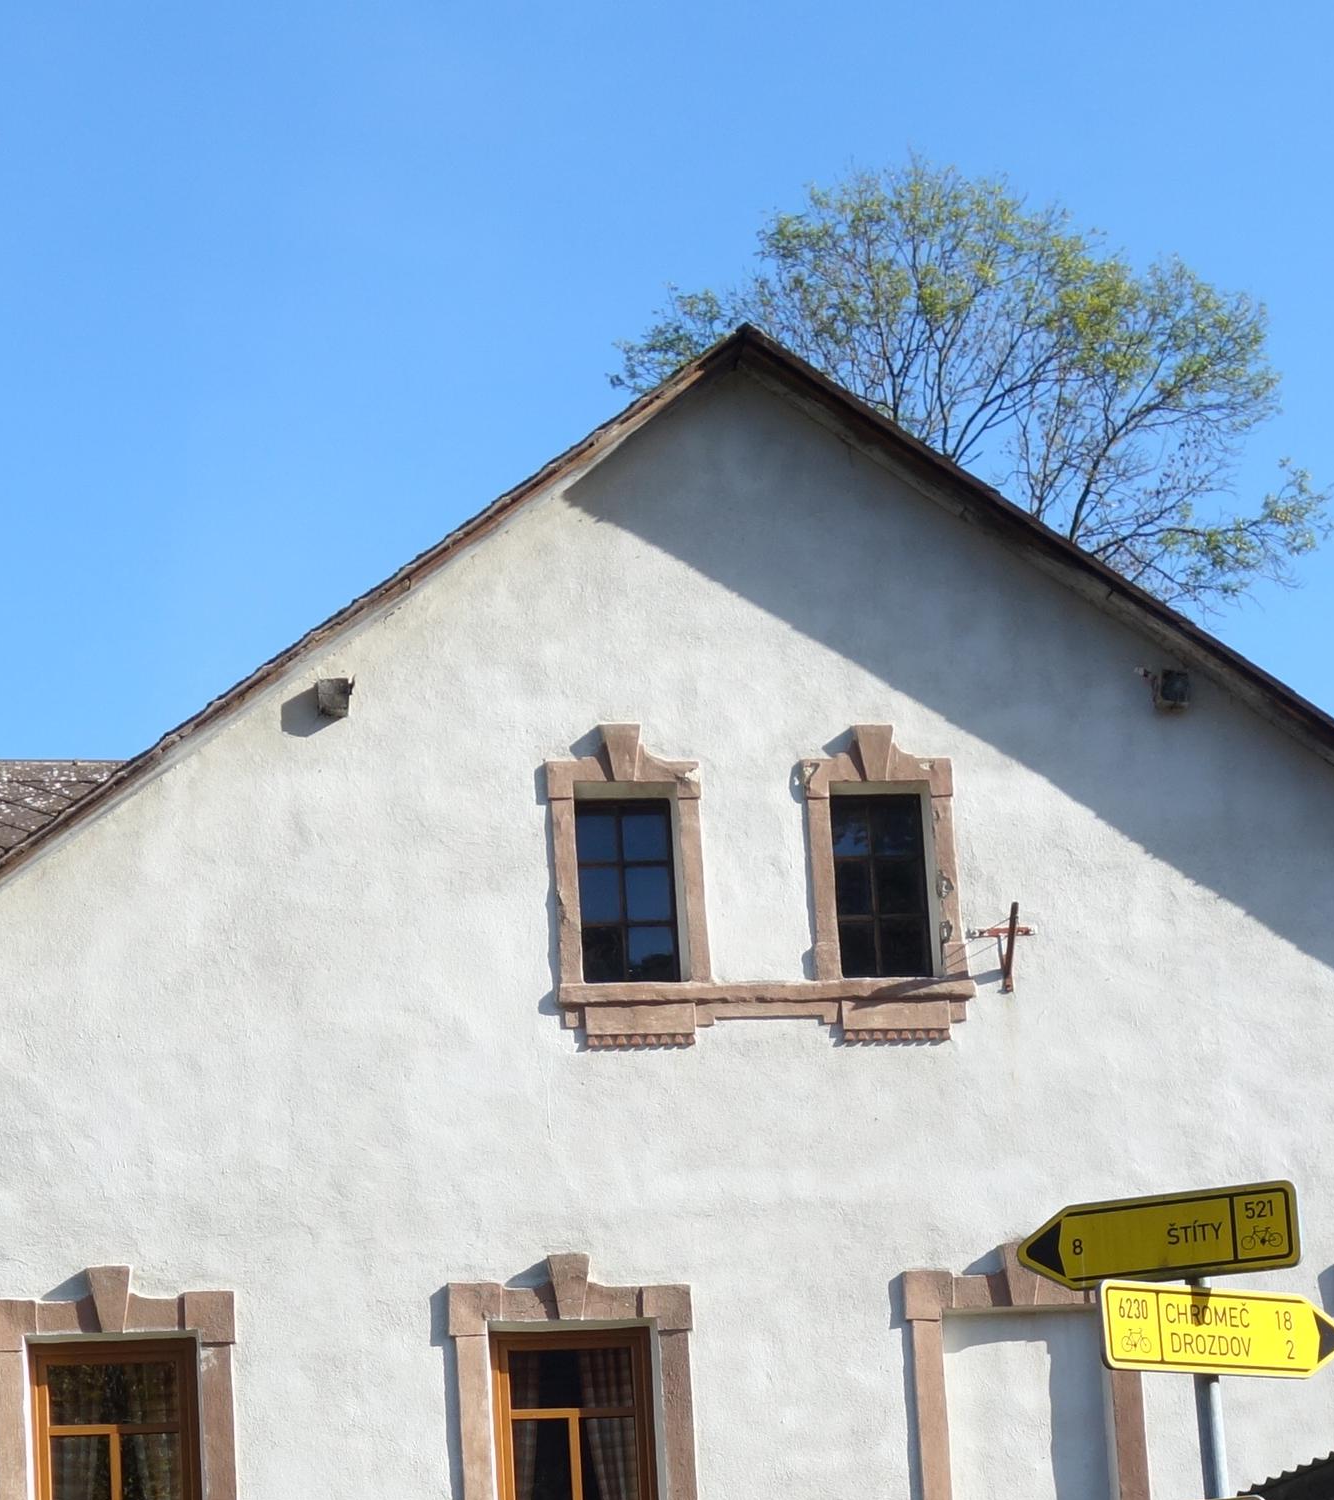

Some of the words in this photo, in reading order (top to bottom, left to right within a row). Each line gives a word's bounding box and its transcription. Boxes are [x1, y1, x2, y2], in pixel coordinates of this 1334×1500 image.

[1244, 1200, 1274, 1220] 521
[1072, 1238, 1083, 1256] 8
[1167, 1220, 1222, 1246] ŠTÍTY
[1118, 1297, 1149, 1321] 6230
[1165, 1303, 1251, 1329] CHROMEČ
[1275, 1310, 1293, 1331] 18
[1170, 1332, 1252, 1358] DROZDOV
[1286, 1340, 1296, 1361] 2
